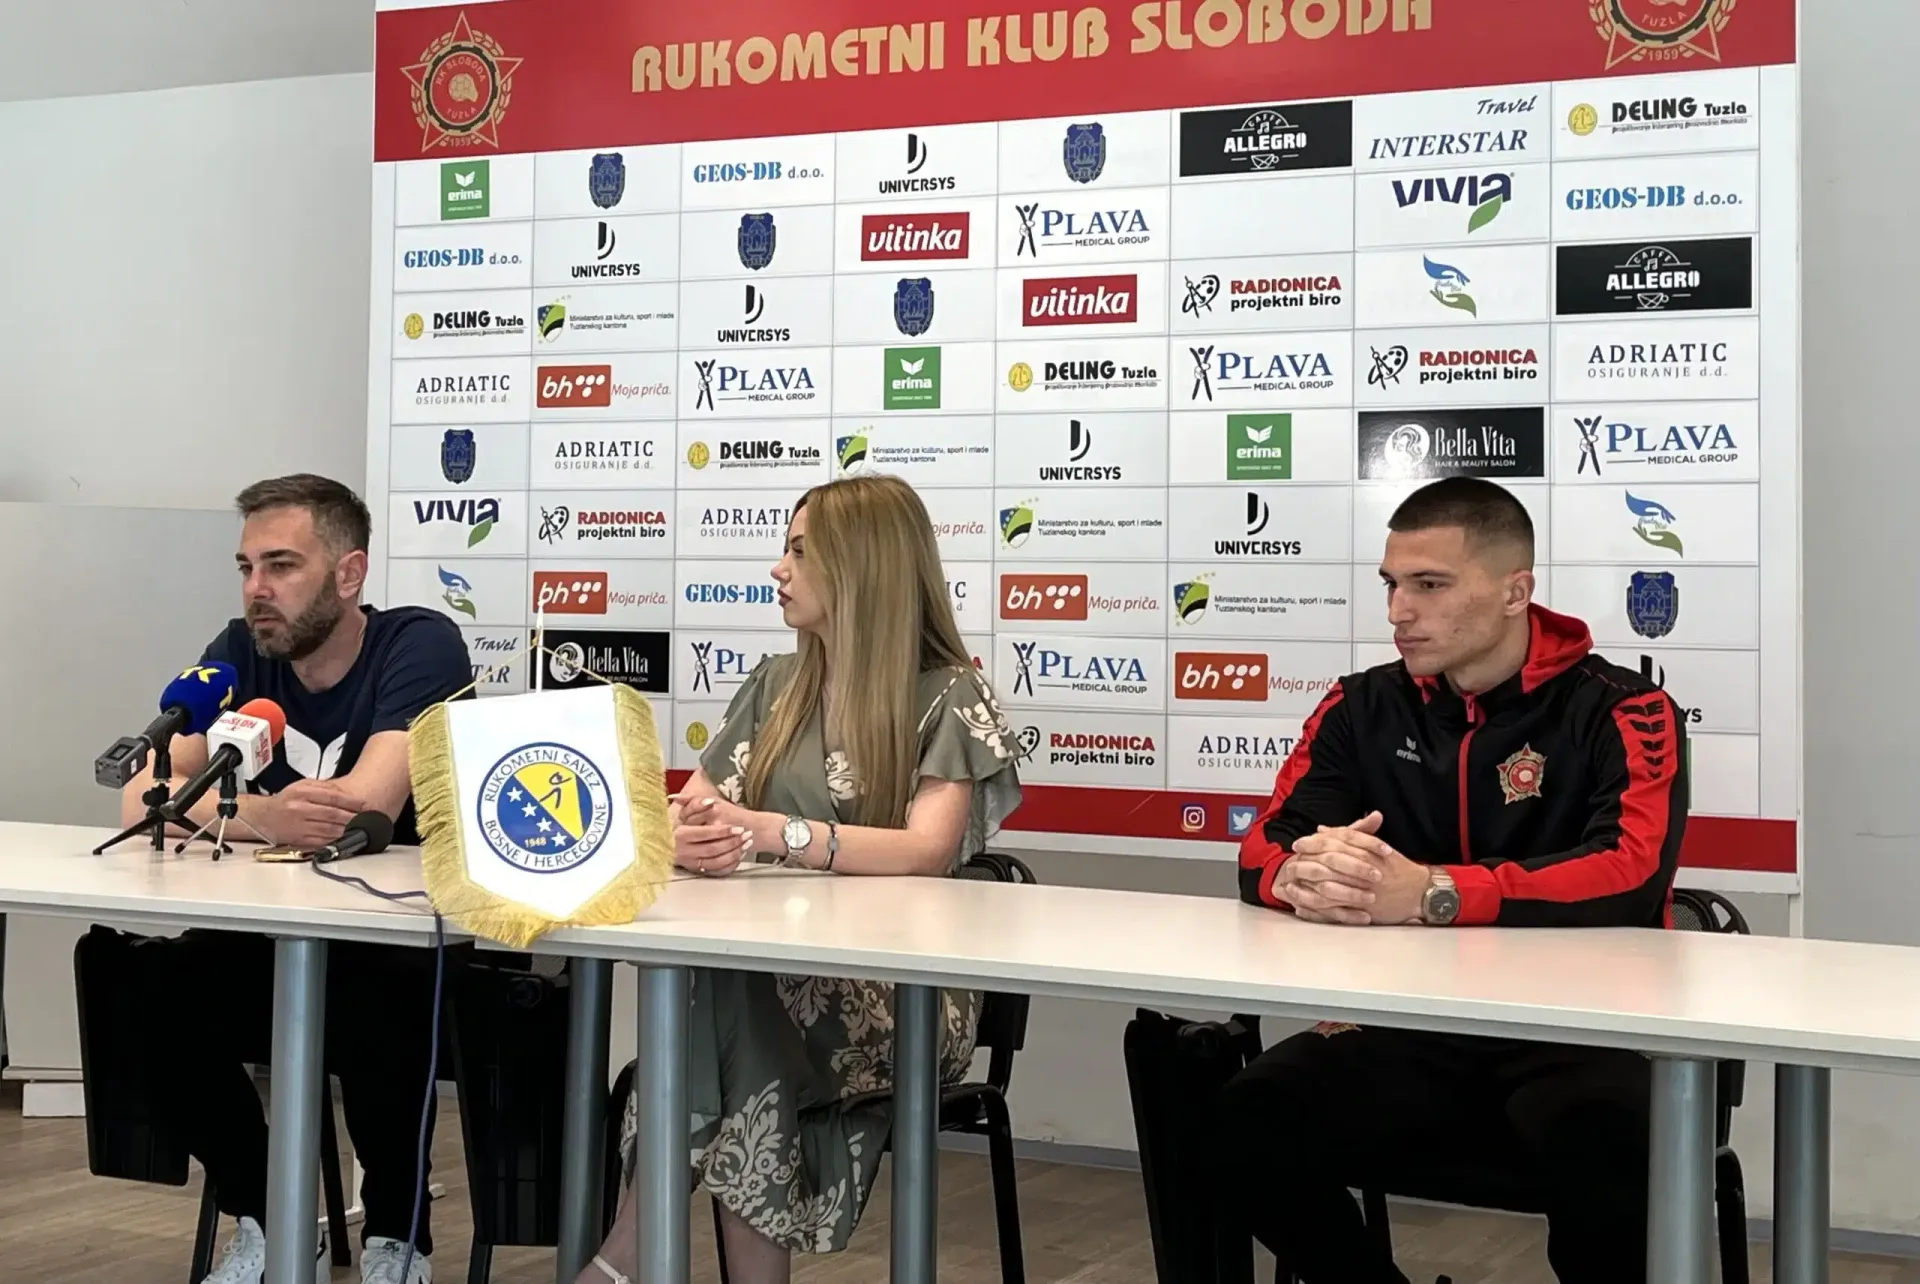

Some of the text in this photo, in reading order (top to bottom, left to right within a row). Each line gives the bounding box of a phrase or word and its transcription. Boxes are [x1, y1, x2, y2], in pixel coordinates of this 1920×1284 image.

[1641, 11, 1687, 27] TUZLA
[631, 0, 1432, 93] RUKOMETNI KLUB SLOBODA
[1648, 48, 1679, 61] 1959
[446, 56, 486, 82] SLOBODA
[447, 106, 476, 119] TUZLA
[1477, 95, 1538, 116] Travel
[1612, 96, 1747, 122] DELING Tuzla
[1224, 132, 1307, 153] ALLEGRO
[1368, 129, 1528, 159] INTERSTAR
[693, 161, 824, 183] GEOS-DB d.o.o.
[879, 176, 955, 194] UNIVERSYS
[448, 188, 483, 202] erima
[1566, 185, 1742, 211] GEOS-DB d.o.o.
[1041, 209, 1150, 236] PLAVA
[867, 222, 963, 252] vitinka
[1075, 235, 1150, 247] MEDICAL GROUP
[404, 248, 522, 268] GEOS-DB d.o.o.
[571, 263, 640, 278] UNIVERSYS
[1230, 276, 1341, 294] RADIONICA
[1606, 270, 1700, 290] ALLEGRO
[1030, 286, 1129, 317] vitinka
[1230, 293, 1341, 311] projektni biro
[433, 310, 524, 330] DELING Tuzla
[717, 328, 790, 342] UNIVERSYS
[1419, 349, 1538, 366] RADIONICA
[1588, 342, 1727, 365] ADRIATIC
[1045, 361, 1157, 381] DELING Tuzla
[1217, 352, 1333, 380] PLAVA
[1419, 366, 1537, 384] projektni biro
[1587, 365, 1728, 379] OSIGURANJE d.d.
[416, 375, 510, 394] ADRIATIC
[717, 365, 815, 391] PLAVA
[892, 377, 932, 390] erima
[1253, 380, 1334, 391] MEDICAL GROUP
[542, 376, 573, 398] bh
[610, 384, 639, 400] Moja
[415, 394, 485, 405] OSIGURANJE
[748, 393, 815, 402] MEDICAL GROUP
[1434, 426, 1516, 457] Bella Vita
[1605, 423, 1737, 453] PLAVA
[555, 440, 654, 458] ADRIATIC
[720, 440, 820, 459] DELING Tuzla
[947, 447, 964, 455] sport
[1236, 446, 1281, 459] erima
[554, 460, 628, 470] OSIGURANJE
[1490, 459, 1516, 467] SALON
[1648, 454, 1738, 465] MEDICAL GROUP
[1039, 466, 1121, 481] UNIVERSYS
[577, 511, 666, 525] RADIONICA
[701, 508, 790, 525] ADRIATI
[1117, 520, 1135, 528] sport
[577, 526, 666, 540] projektni biro
[700, 528, 777, 538] OSIGURANJE
[932, 523, 949, 537] oja
[1214, 541, 1301, 555] UNIVERSYS
[608, 592, 635, 607] Moja
[685, 583, 774, 603] GEOS-DB
[1006, 585, 1160, 613] bh Moja priča.
[1299, 597, 1318, 606] sport
[474, 636, 518, 651] Travel
[588, 645, 648, 674] Bella Vita
[1037, 650, 1147, 682] PLAVA
[1181, 663, 1333, 694] bh Moja prič
[1072, 683, 1147, 694] MEDICAL GROUP
[1050, 733, 1155, 751] RADIONICA
[1198, 735, 1294, 756] ADRIAT
[1050, 750, 1155, 767] projektni biro
[1197, 757, 1280, 771] OSIGURANJ
[484, 749, 601, 802] RUKOMETNI SAVEZ
[485, 803, 607, 868] BOSNE I HERCEGOVINE
